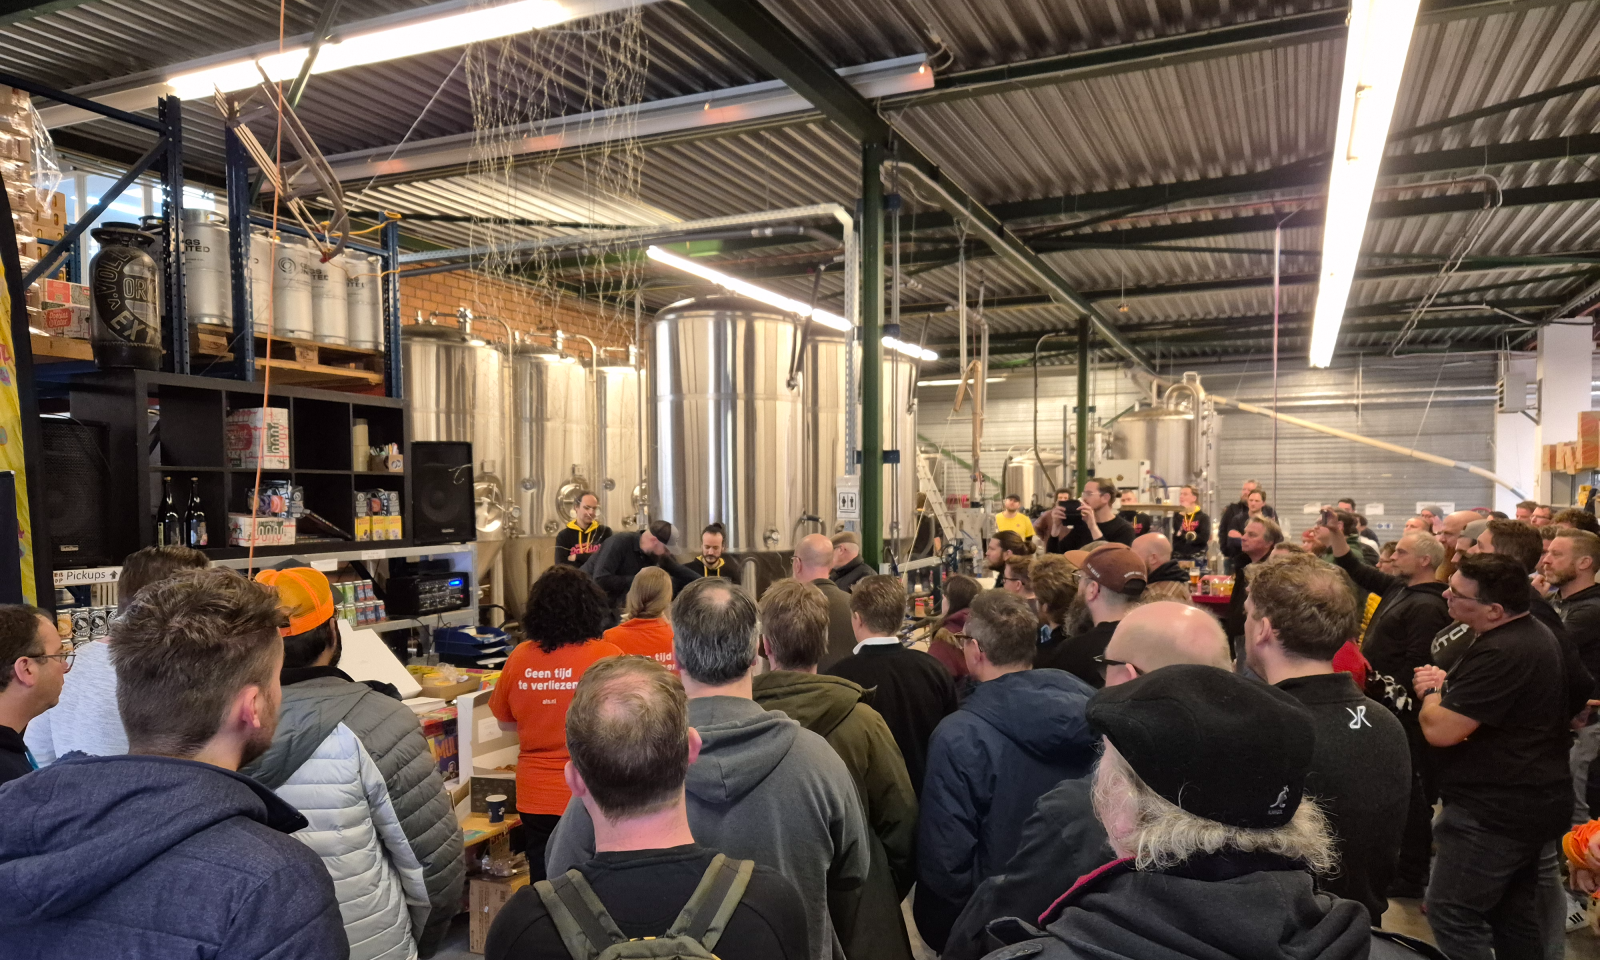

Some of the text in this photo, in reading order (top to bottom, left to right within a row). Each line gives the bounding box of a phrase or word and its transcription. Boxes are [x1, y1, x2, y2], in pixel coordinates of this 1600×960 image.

[66, 570, 106, 581] Pickups
[655, 652, 672, 662] tijd
[525, 668, 572, 679] Geen tijd
[518, 680, 578, 690] te verliezen
